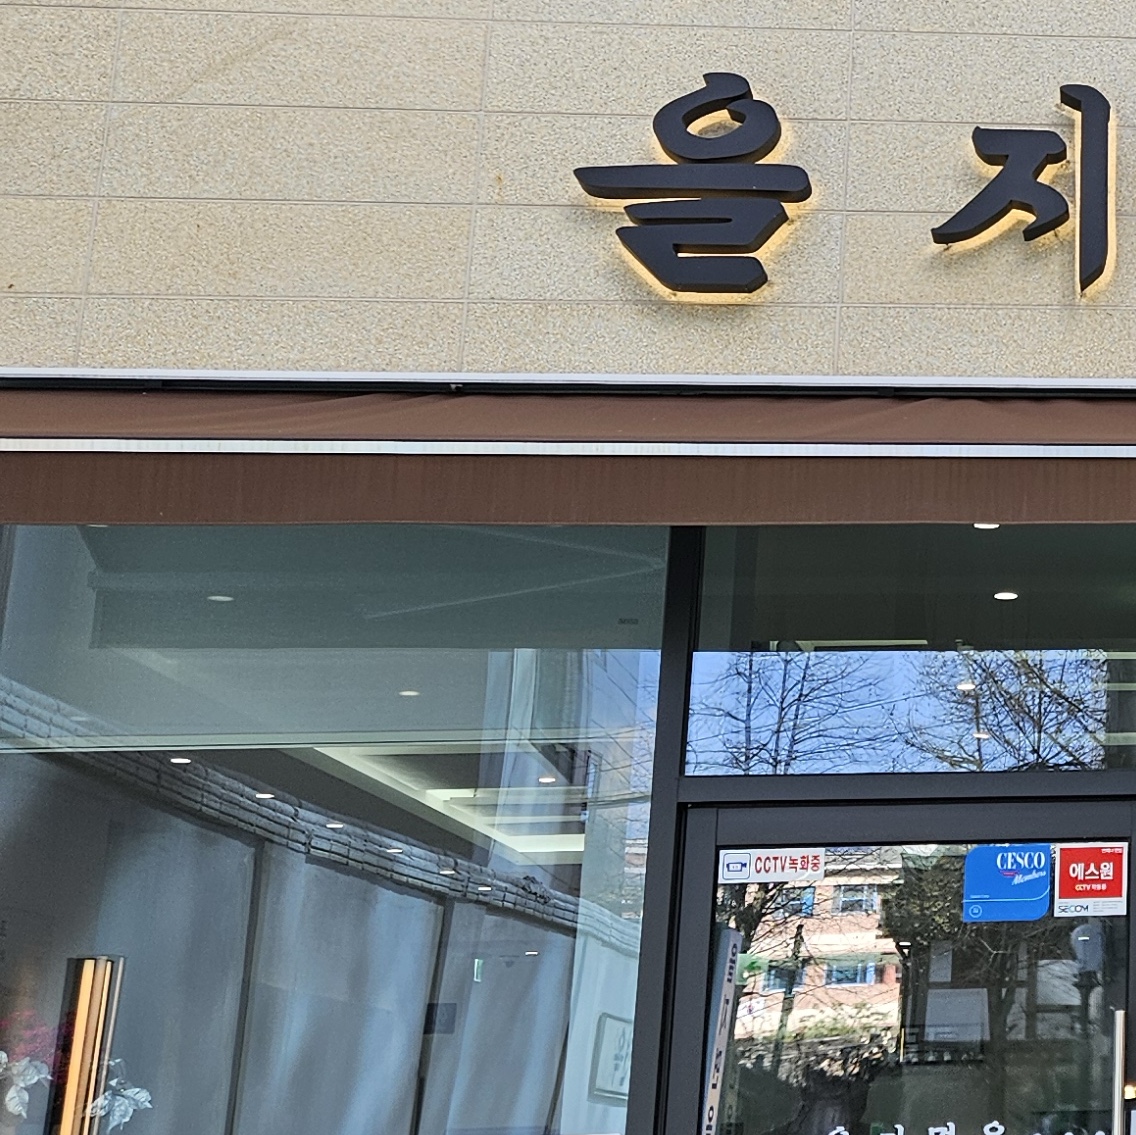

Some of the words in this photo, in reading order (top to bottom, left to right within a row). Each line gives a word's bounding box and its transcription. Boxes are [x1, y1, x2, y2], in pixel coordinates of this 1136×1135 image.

[755, 855, 820, 873] CCTV녹화중
[996, 851, 1046, 870] CESCO
[1011, 870, 1047, 885] Members
[1069, 862, 1114, 880] 에스원
[1058, 904, 1089, 913] SECOM
